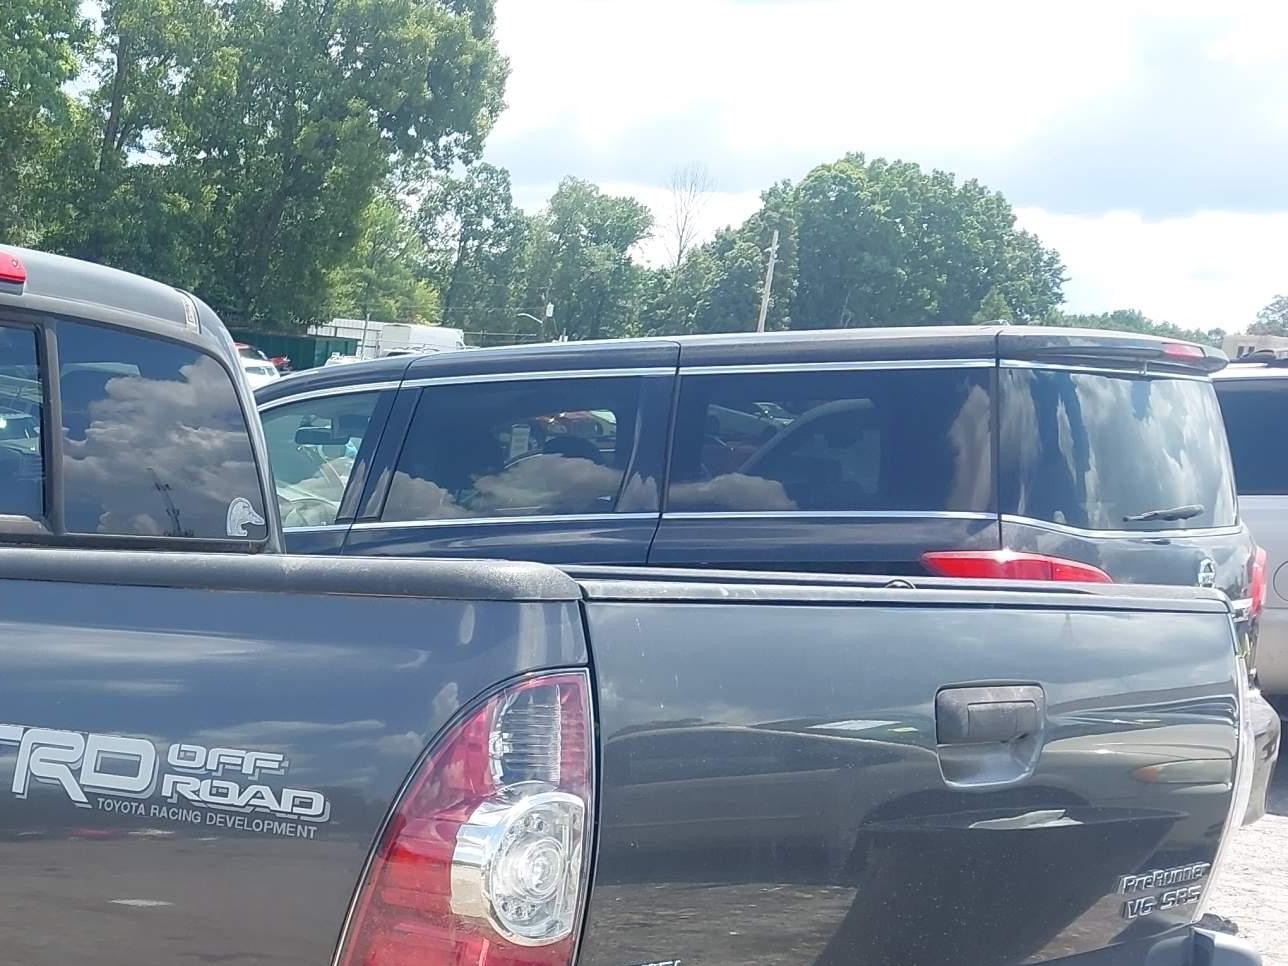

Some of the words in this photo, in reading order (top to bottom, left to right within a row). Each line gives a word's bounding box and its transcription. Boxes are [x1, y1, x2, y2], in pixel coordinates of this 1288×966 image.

[167, 743, 290, 781] OFF
[96, 797, 147, 817] TOYOTA
[149, 804, 202, 825] RACING
[205, 813, 318, 840] DEVELOPMENT
[161, 774, 332, 824] ROAD
